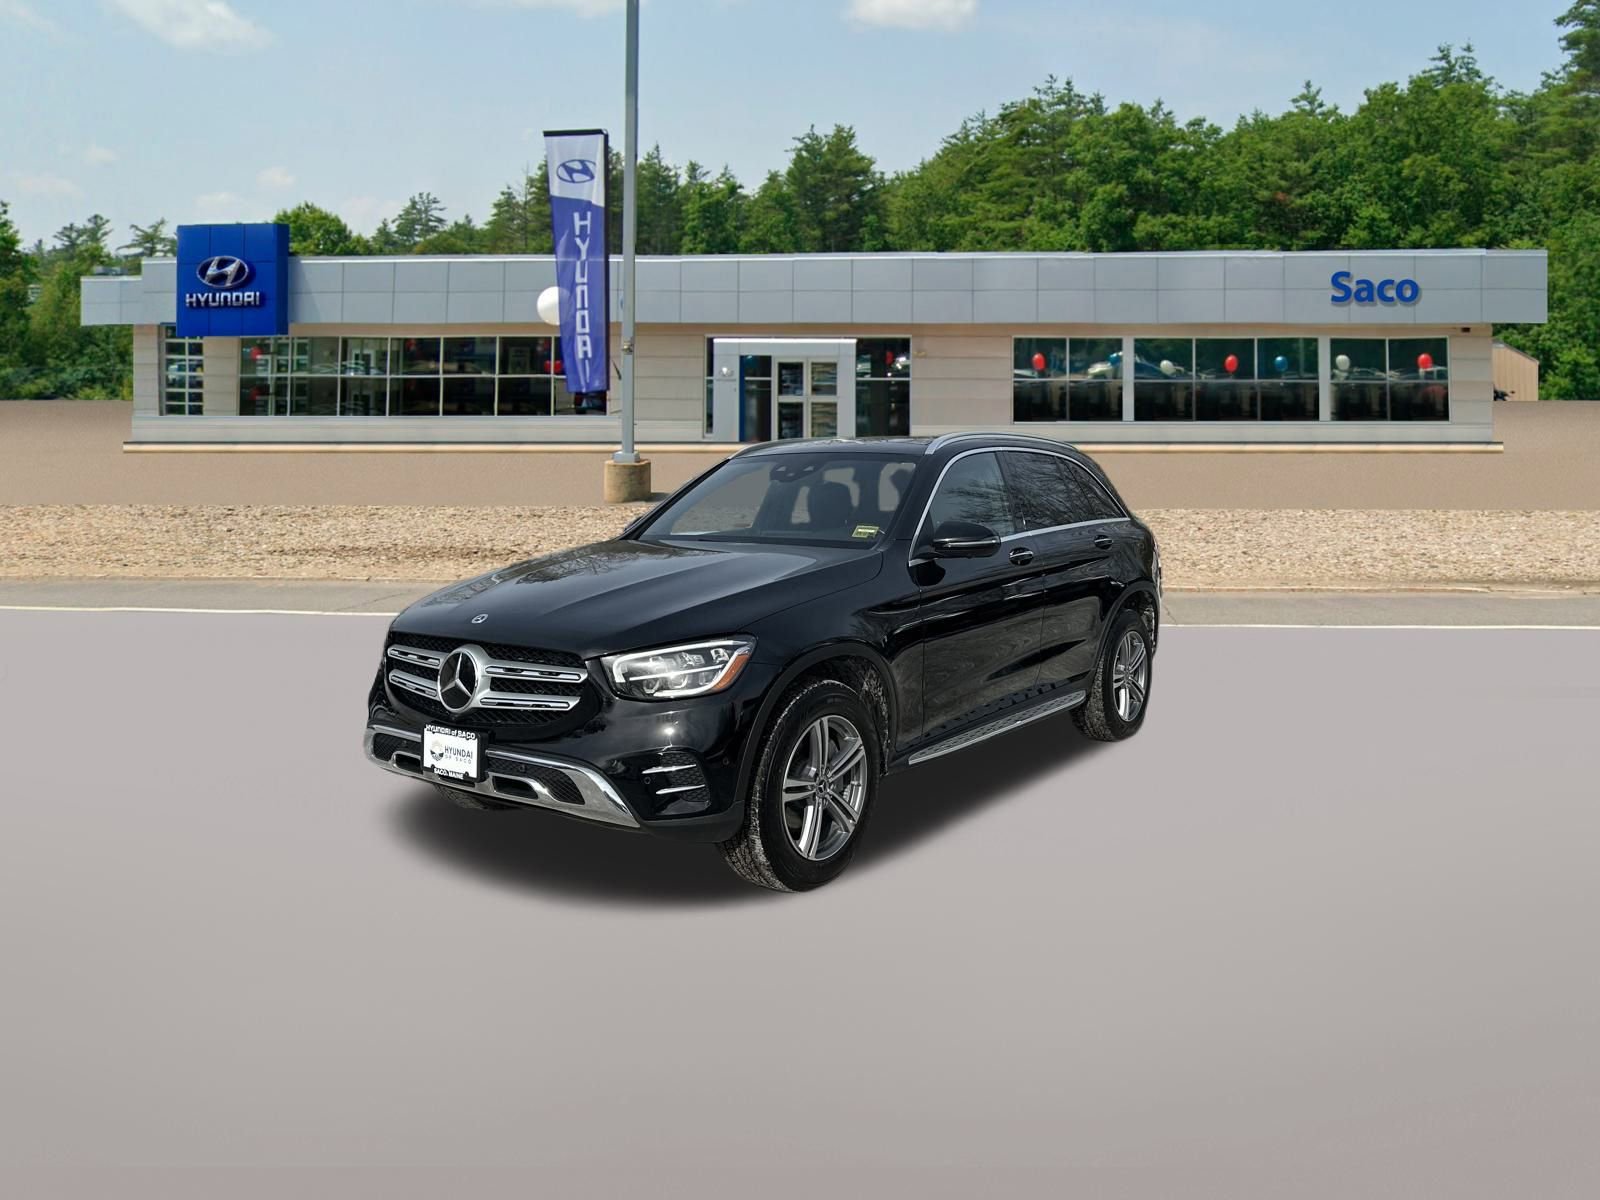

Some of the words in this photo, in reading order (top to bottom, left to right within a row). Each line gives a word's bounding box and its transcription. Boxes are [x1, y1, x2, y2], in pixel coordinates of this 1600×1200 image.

[1331, 271, 1420, 303] Saco
[185, 291, 260, 308] HYUNDAI
[573, 211, 593, 384] HYUNDAI
[425, 724, 451, 734] HYUNDAI
[458, 730, 475, 739] SACO
[444, 745, 473, 760] HYUNDAI
